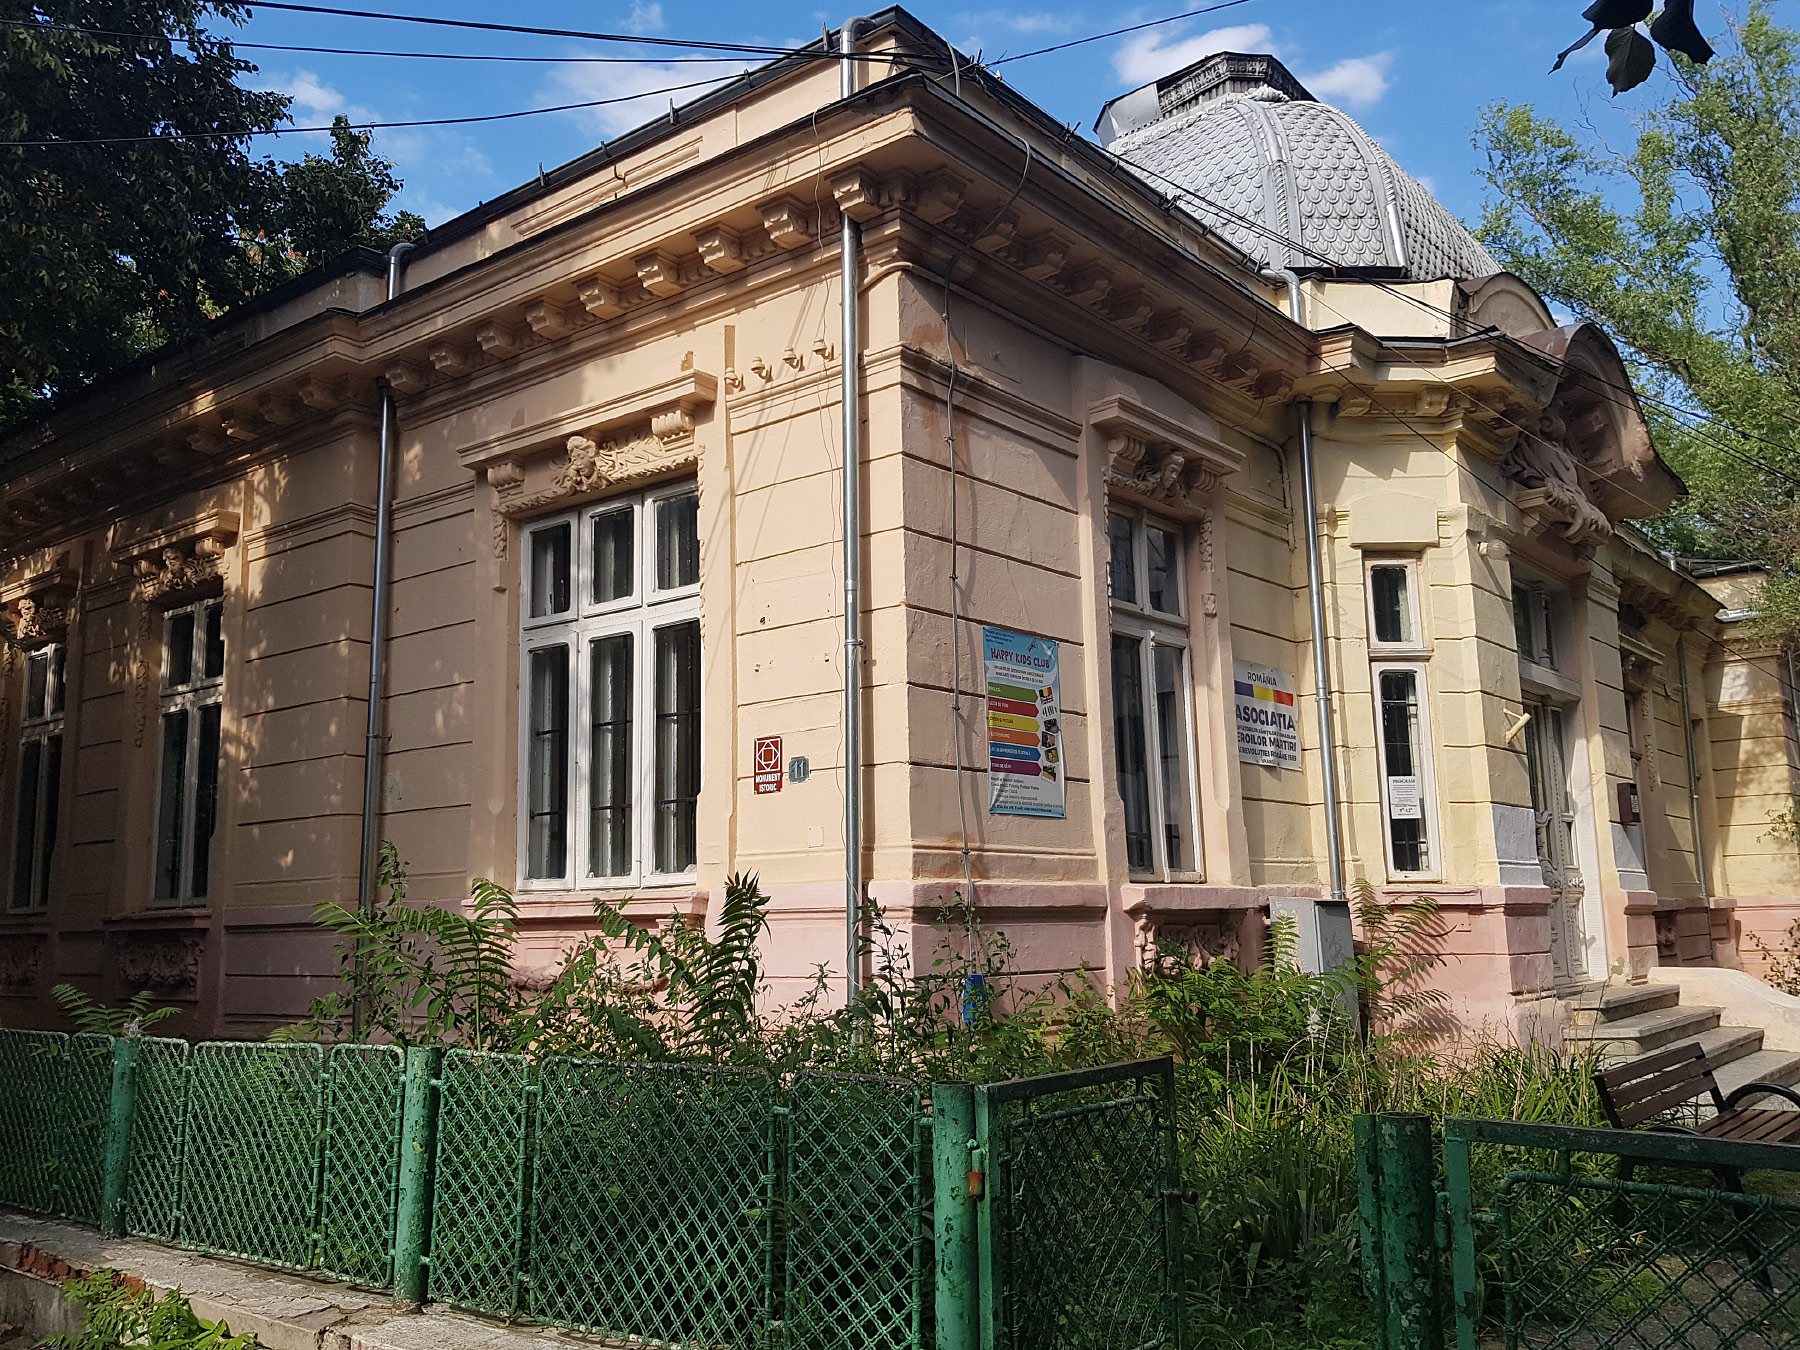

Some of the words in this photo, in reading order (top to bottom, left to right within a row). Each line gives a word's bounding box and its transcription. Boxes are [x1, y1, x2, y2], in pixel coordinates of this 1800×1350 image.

[990, 648, 1013, 662] HAPPY
[1015, 652, 1032, 666] KIDS
[1033, 657, 1050, 669] CLUB
[1247, 672, 1277, 686] ROMÂNIA
[1237, 731, 1267, 747] EROILOR
[1268, 736, 1297, 752] MARTIRI
[756, 772, 781, 783] MONUMENT
[792, 760, 804, 779] 11
[759, 783, 777, 792] ISTORIC
